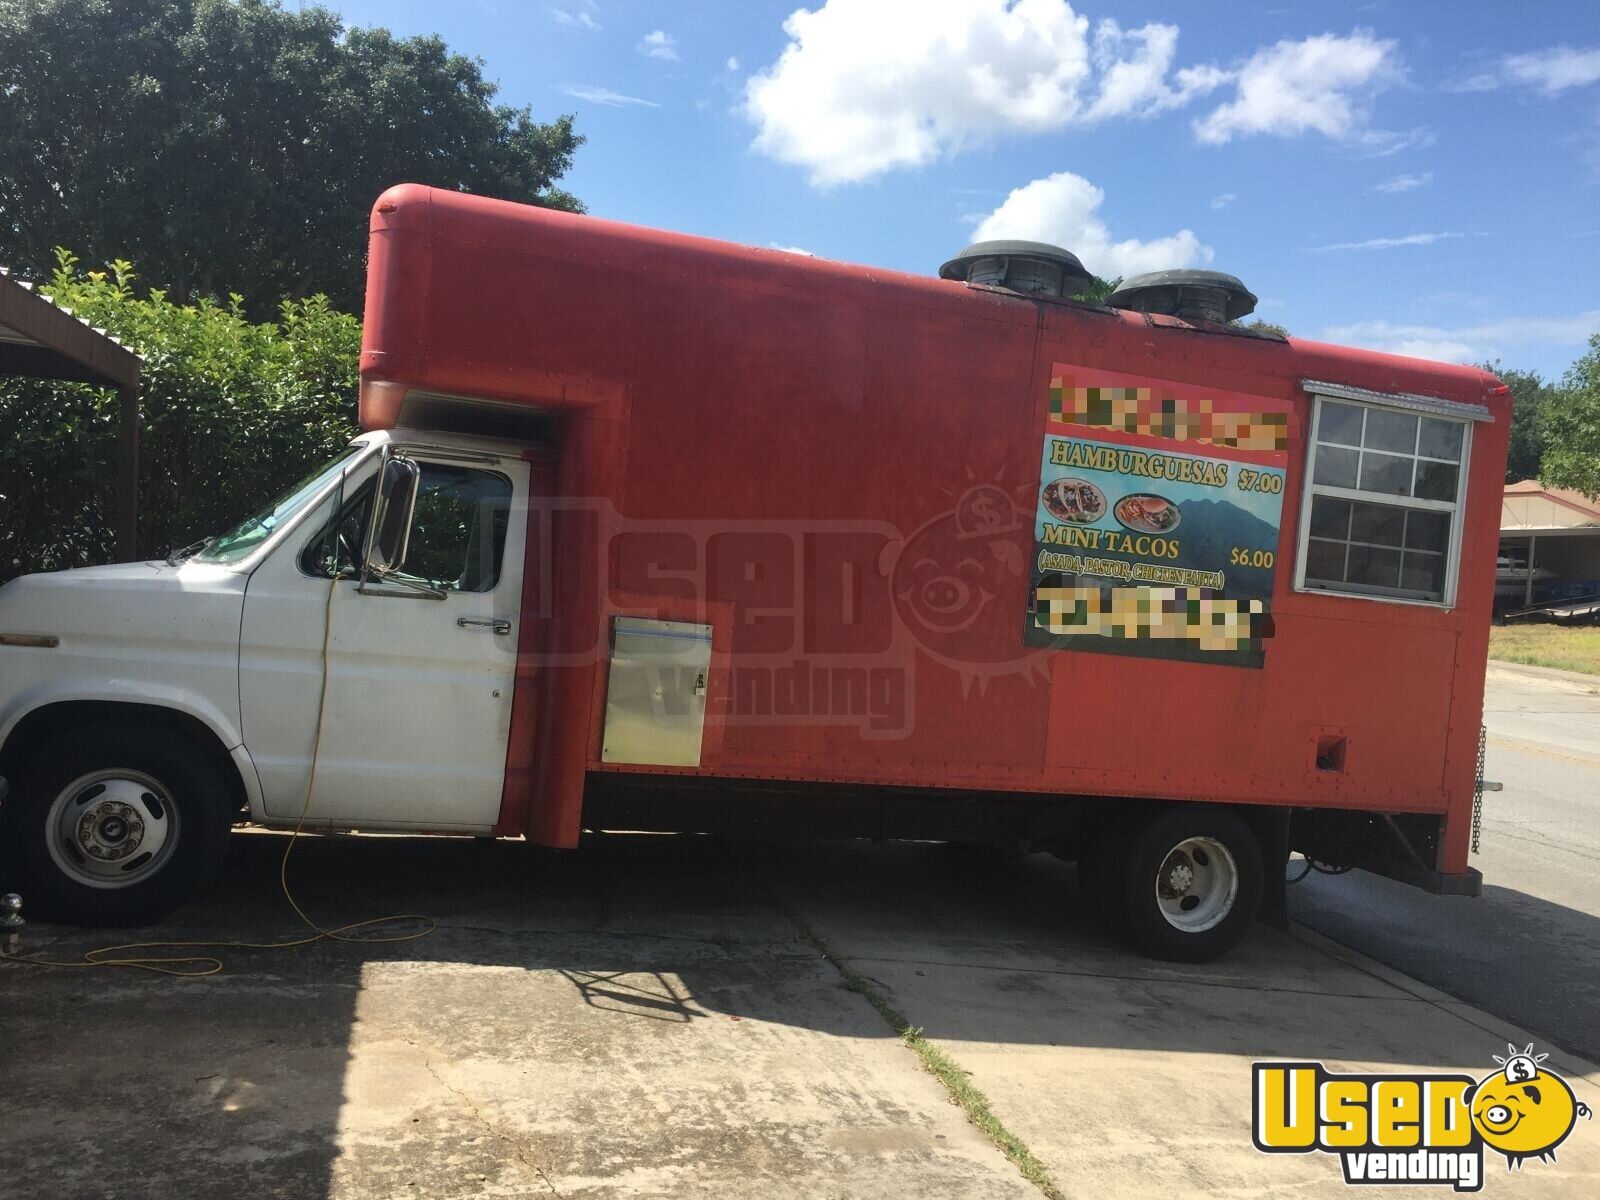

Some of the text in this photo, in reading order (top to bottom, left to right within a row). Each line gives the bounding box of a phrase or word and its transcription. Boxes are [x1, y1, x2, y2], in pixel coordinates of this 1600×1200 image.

[1051, 440, 1282, 494] HAMBURGUESAS $7.00
[1042, 523, 1274, 569] MINI TACOS $6.00
[1132, 563, 1184, 586] CHICKEN
